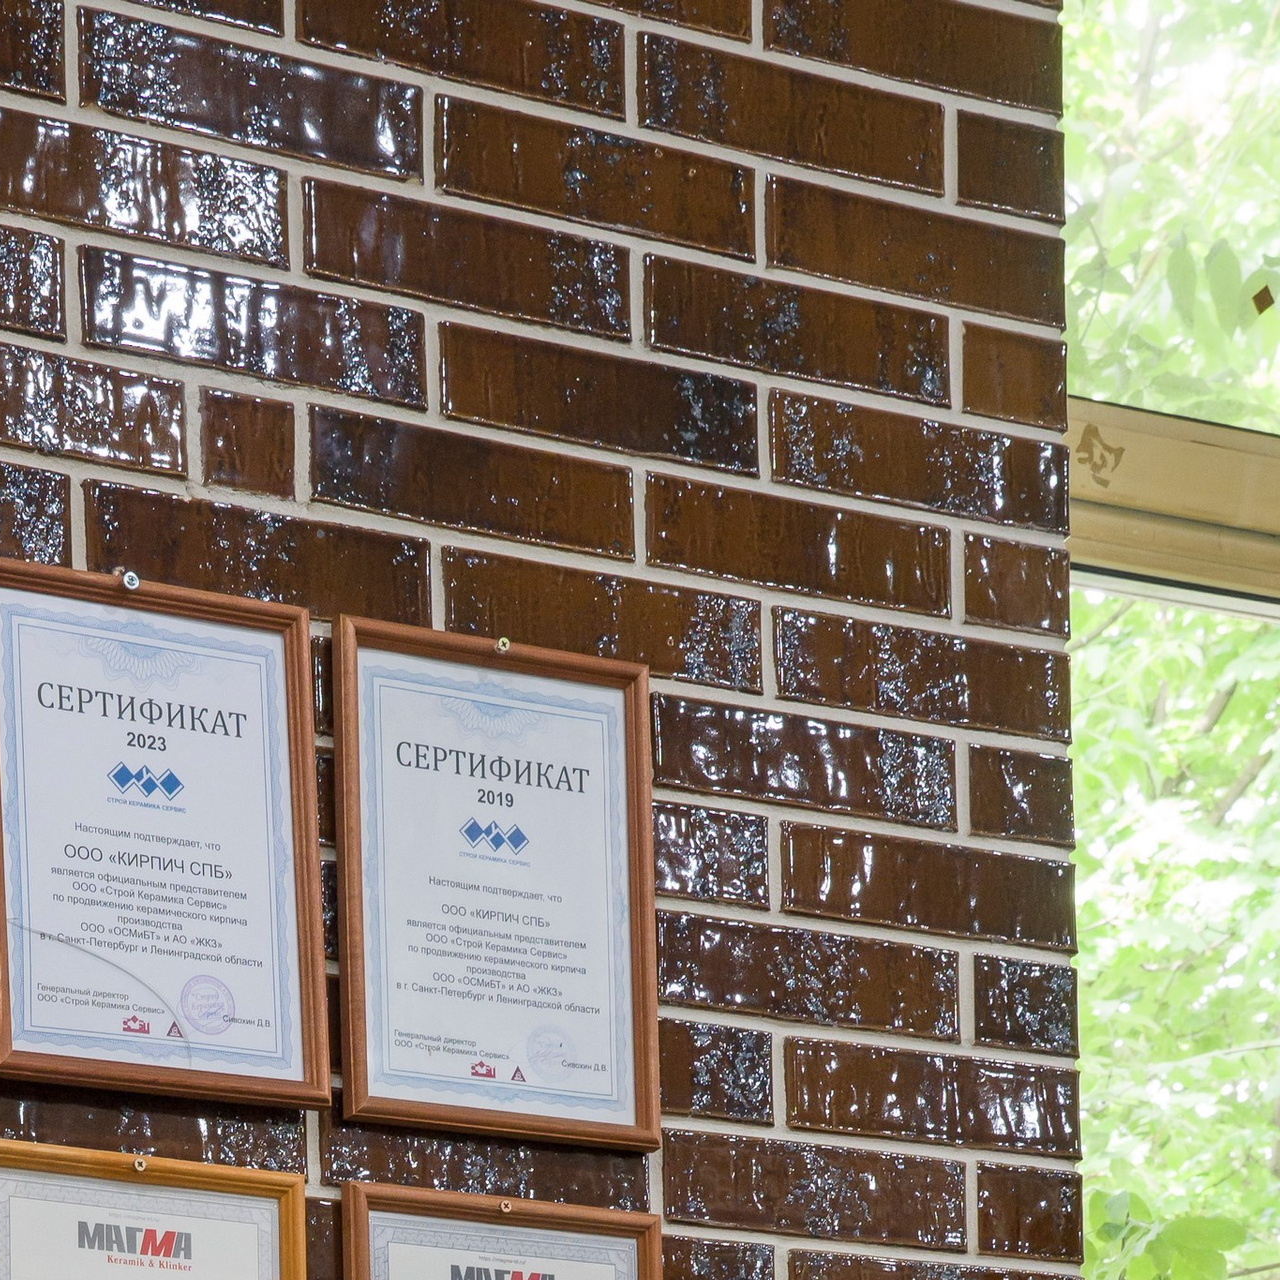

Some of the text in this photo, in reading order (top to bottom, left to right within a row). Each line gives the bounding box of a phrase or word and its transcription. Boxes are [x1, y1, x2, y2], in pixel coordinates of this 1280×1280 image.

[37, 682, 247, 738] СЕРТИФИКАТ
[127, 732, 167, 752] 2023
[396, 741, 590, 793] СЕРТИФИКАТ
[106, 796, 187, 814] СТРОЙ КЕРАМИКА СЕРВИС
[477, 789, 514, 808] 2019
[64, 844, 232, 879] ООО «КИРПИЧ СПБ»
[441, 904, 550, 928] ООО «КИРПИЧ СПБ»
[425, 932, 567, 960] ООО «Строй Керамика Сервис»
[78, 1221, 192, 1260] МАГМА
[107, 1254, 145, 1267] Keramik
[158, 1259, 192, 1272] Klinker
